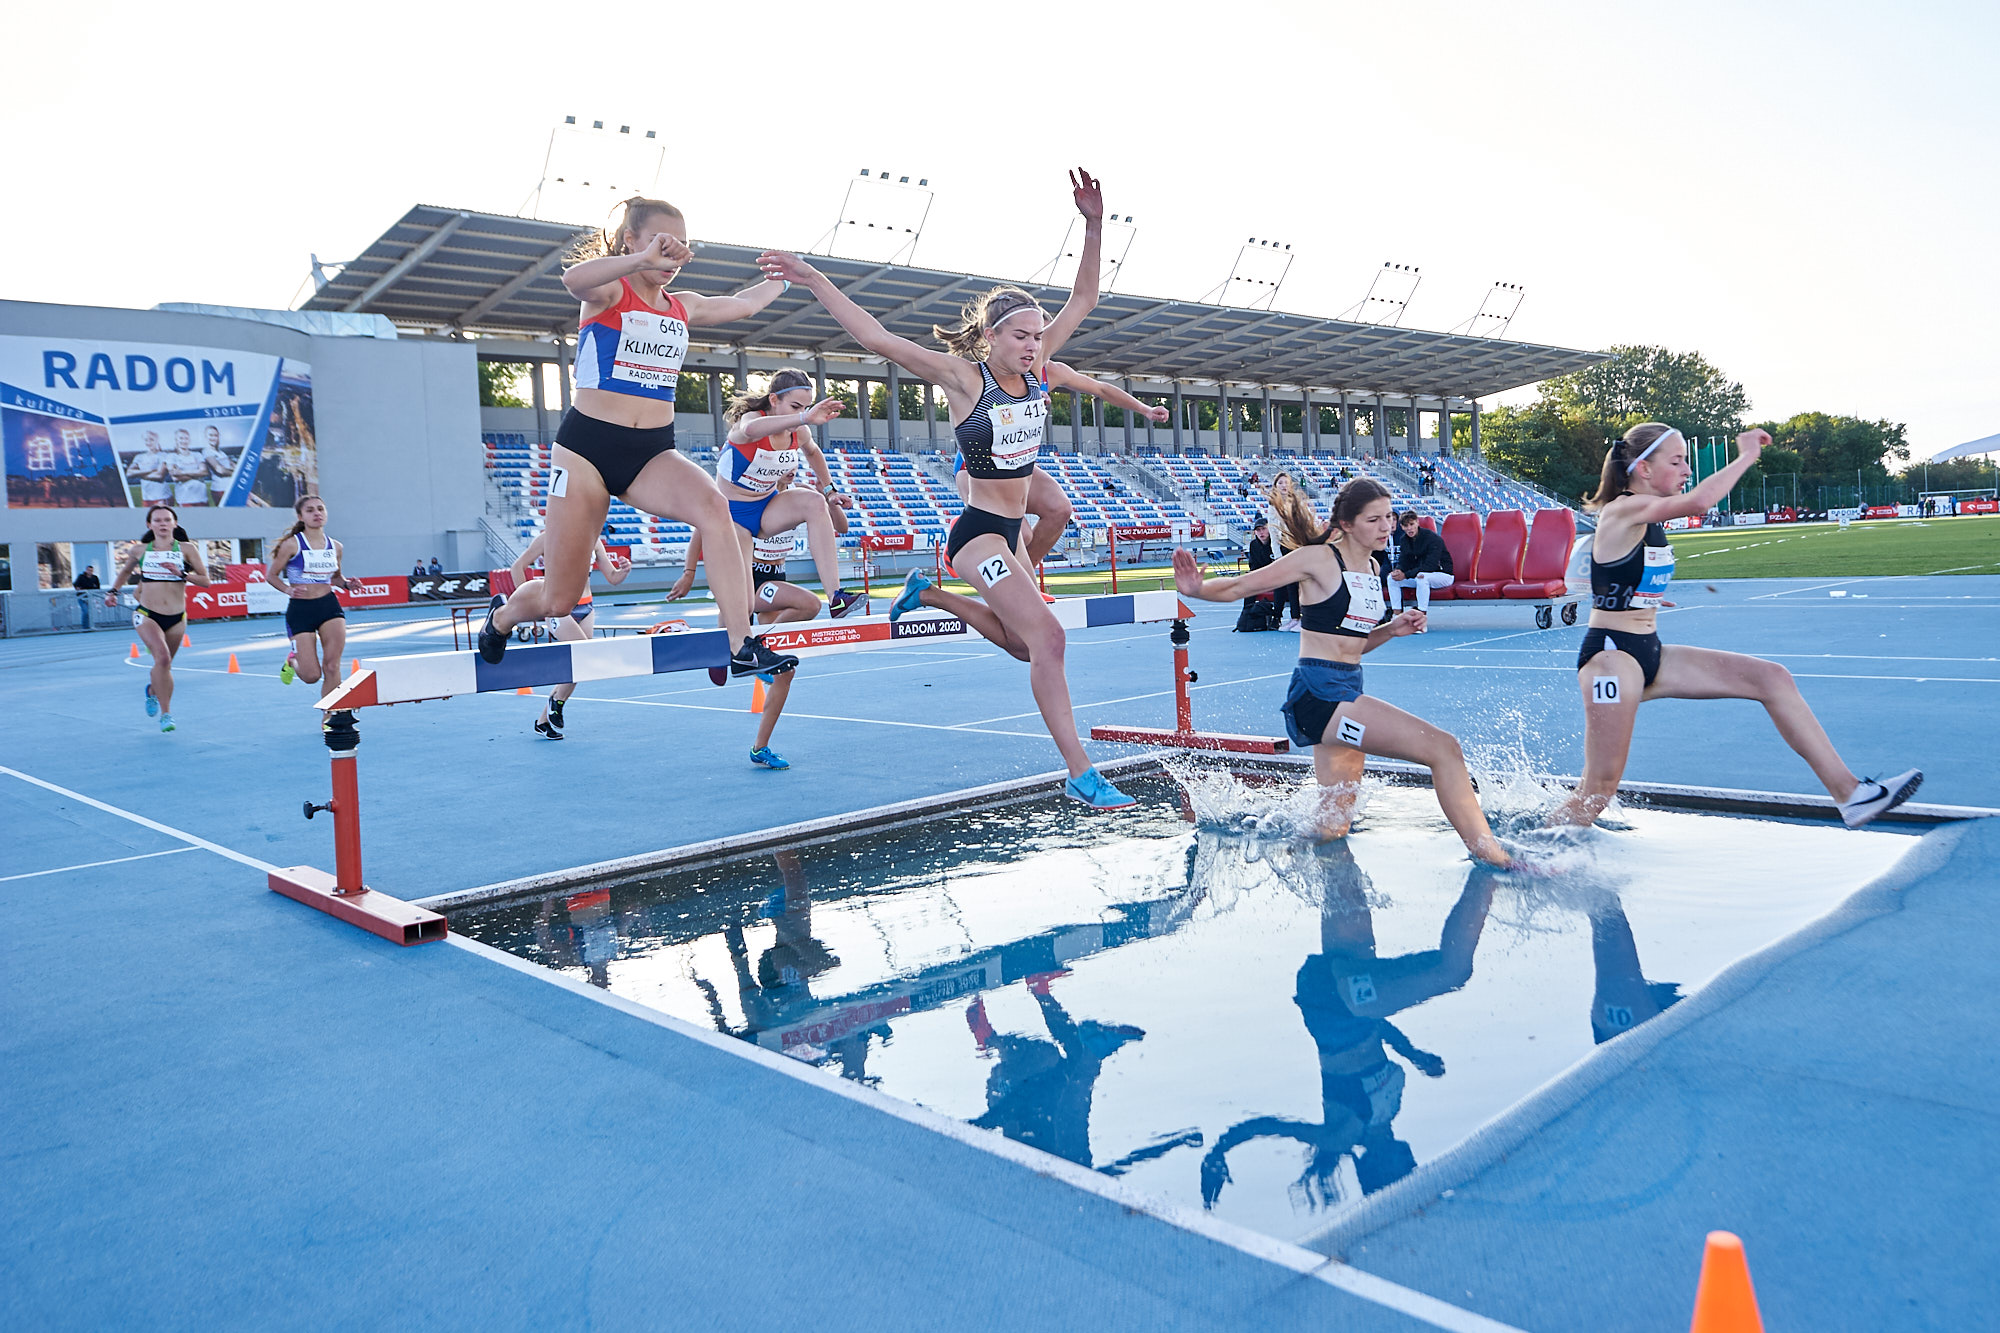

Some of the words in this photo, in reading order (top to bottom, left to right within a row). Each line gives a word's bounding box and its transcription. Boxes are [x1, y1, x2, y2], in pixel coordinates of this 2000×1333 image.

[660, 318, 684, 336] 649
[42, 350, 236, 397] RADOM
[629, 369, 660, 381] RADOM
[662, 374, 677, 383] 202
[15, 394, 84, 420] kultura
[204, 405, 243, 418] sport
[778, 452, 795, 463] 651
[1005, 457, 1027, 466] RADOM
[237, 450, 259, 491] rozwój
[552, 469, 563, 493] 7
[1769, 513, 1791, 521] PZLA
[752, 562, 772, 573] PRO
[982, 559, 1008, 581] 12
[411, 581, 434, 594] 4F
[438, 580, 460, 593] 4F
[464, 578, 487, 591] 4F
[352, 588, 386, 596] ORLEN
[763, 586, 774, 598] 6
[220, 594, 247, 604] ORLE
[1365, 598, 1377, 610] SOT
[812, 629, 856, 638] MISTRZOSTWA
[898, 623, 936, 636] RADOM
[939, 621, 961, 632] 2020
[766, 633, 807, 648] PZLA
[1593, 681, 1617, 699] 10
[1341, 722, 1360, 742] 11
